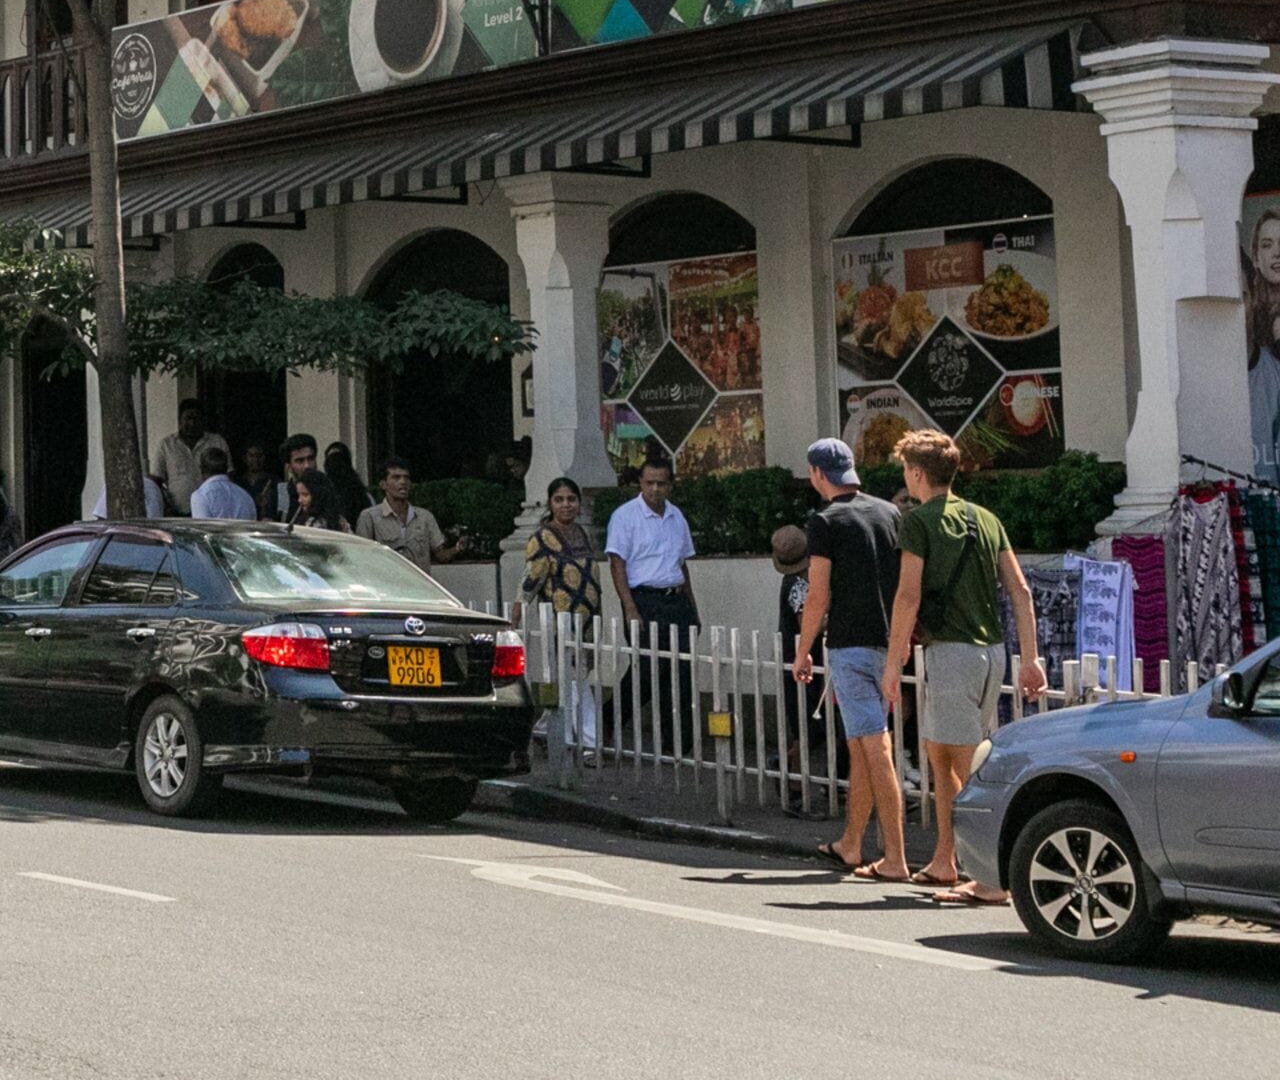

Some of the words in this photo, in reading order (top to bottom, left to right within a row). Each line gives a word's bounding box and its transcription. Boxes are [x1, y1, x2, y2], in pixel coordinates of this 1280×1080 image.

[484, 7, 513, 27] Level
[515, 6, 523, 21] 2
[1012, 235, 1035, 248] THAI
[859, 251, 894, 265] ITALIAN
[926, 256, 963, 281] KCC
[866, 397, 899, 410] INDIAN
[405, 648, 424, 666] KD
[397, 667, 435, 684] 9906
